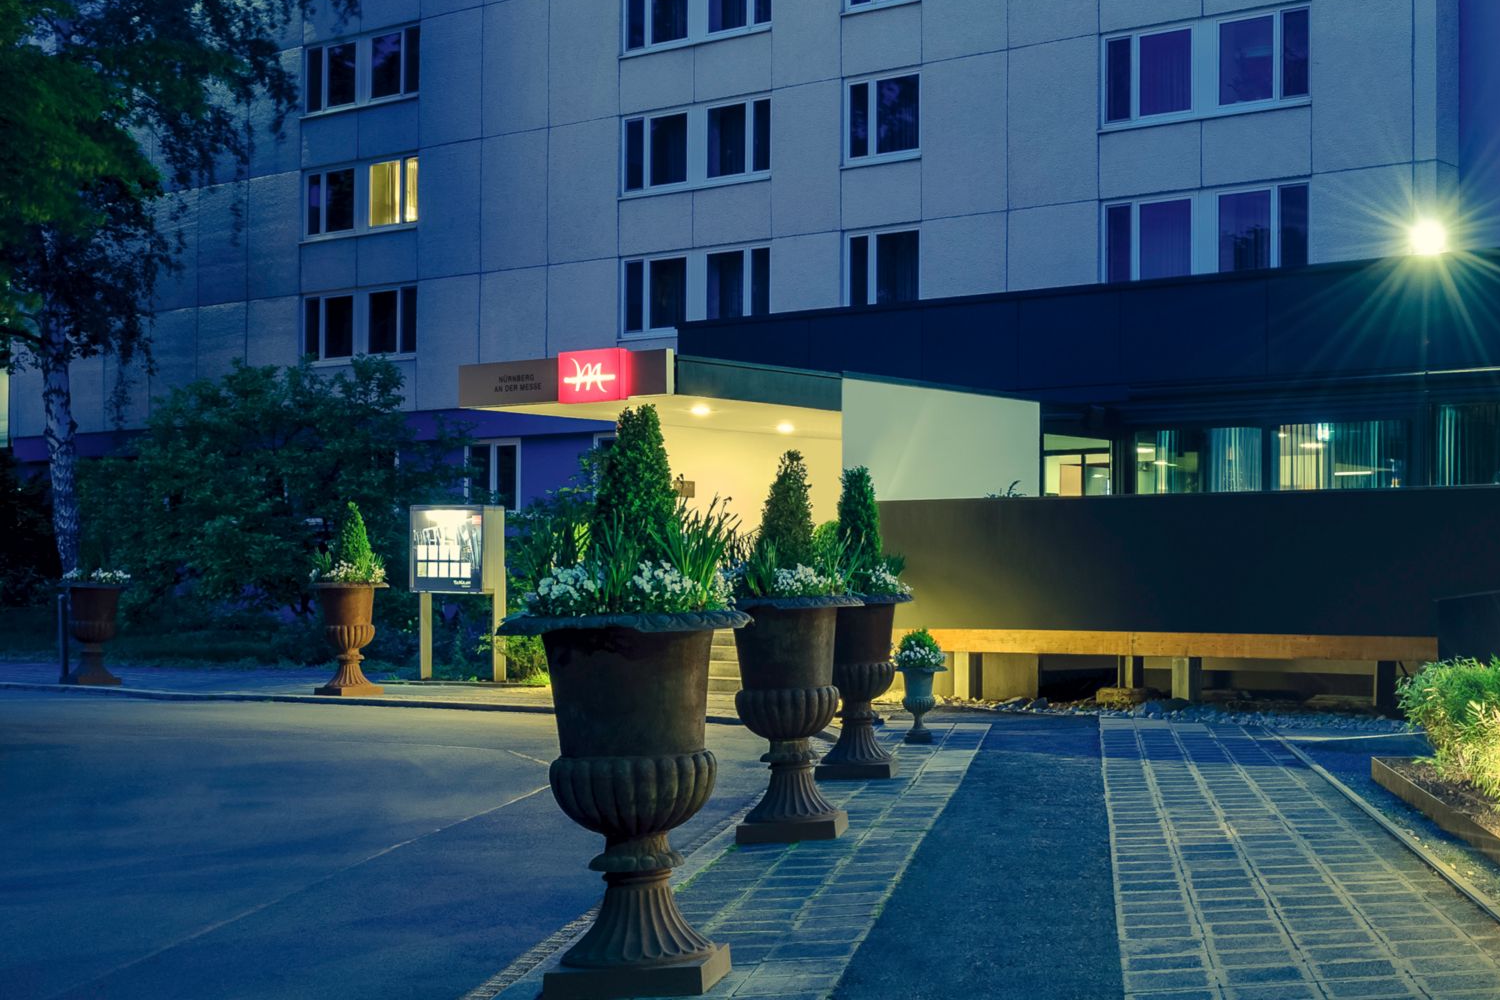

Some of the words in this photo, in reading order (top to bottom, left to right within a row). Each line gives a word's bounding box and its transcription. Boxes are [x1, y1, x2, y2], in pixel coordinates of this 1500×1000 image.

[494, 385, 503, 393] AN
[504, 384, 518, 392] DER
[519, 382, 542, 391] MESSE
